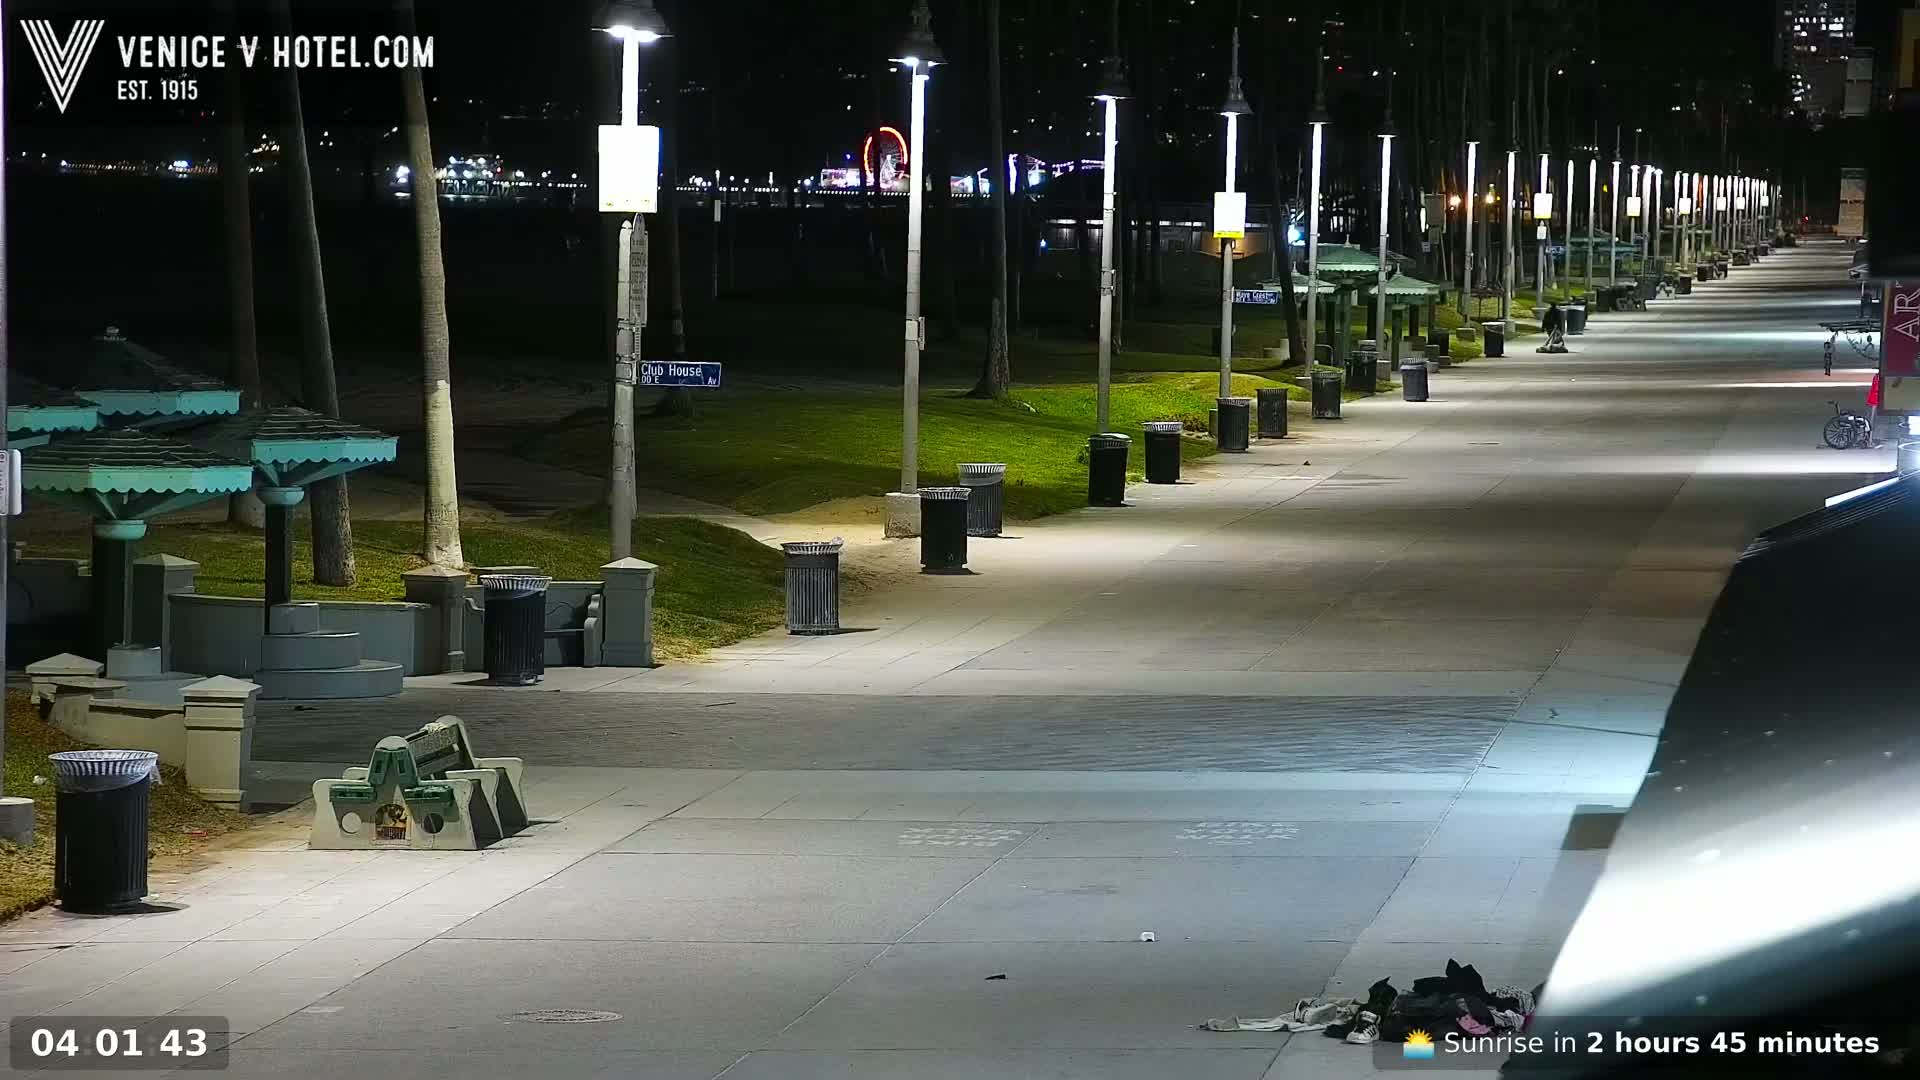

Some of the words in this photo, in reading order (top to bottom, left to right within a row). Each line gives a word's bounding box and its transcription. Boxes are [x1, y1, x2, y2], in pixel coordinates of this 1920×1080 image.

[641, 363, 664, 376] Club
[669, 364, 701, 377] House
[654, 375, 660, 384] E
[707, 376, 717, 385] Av
